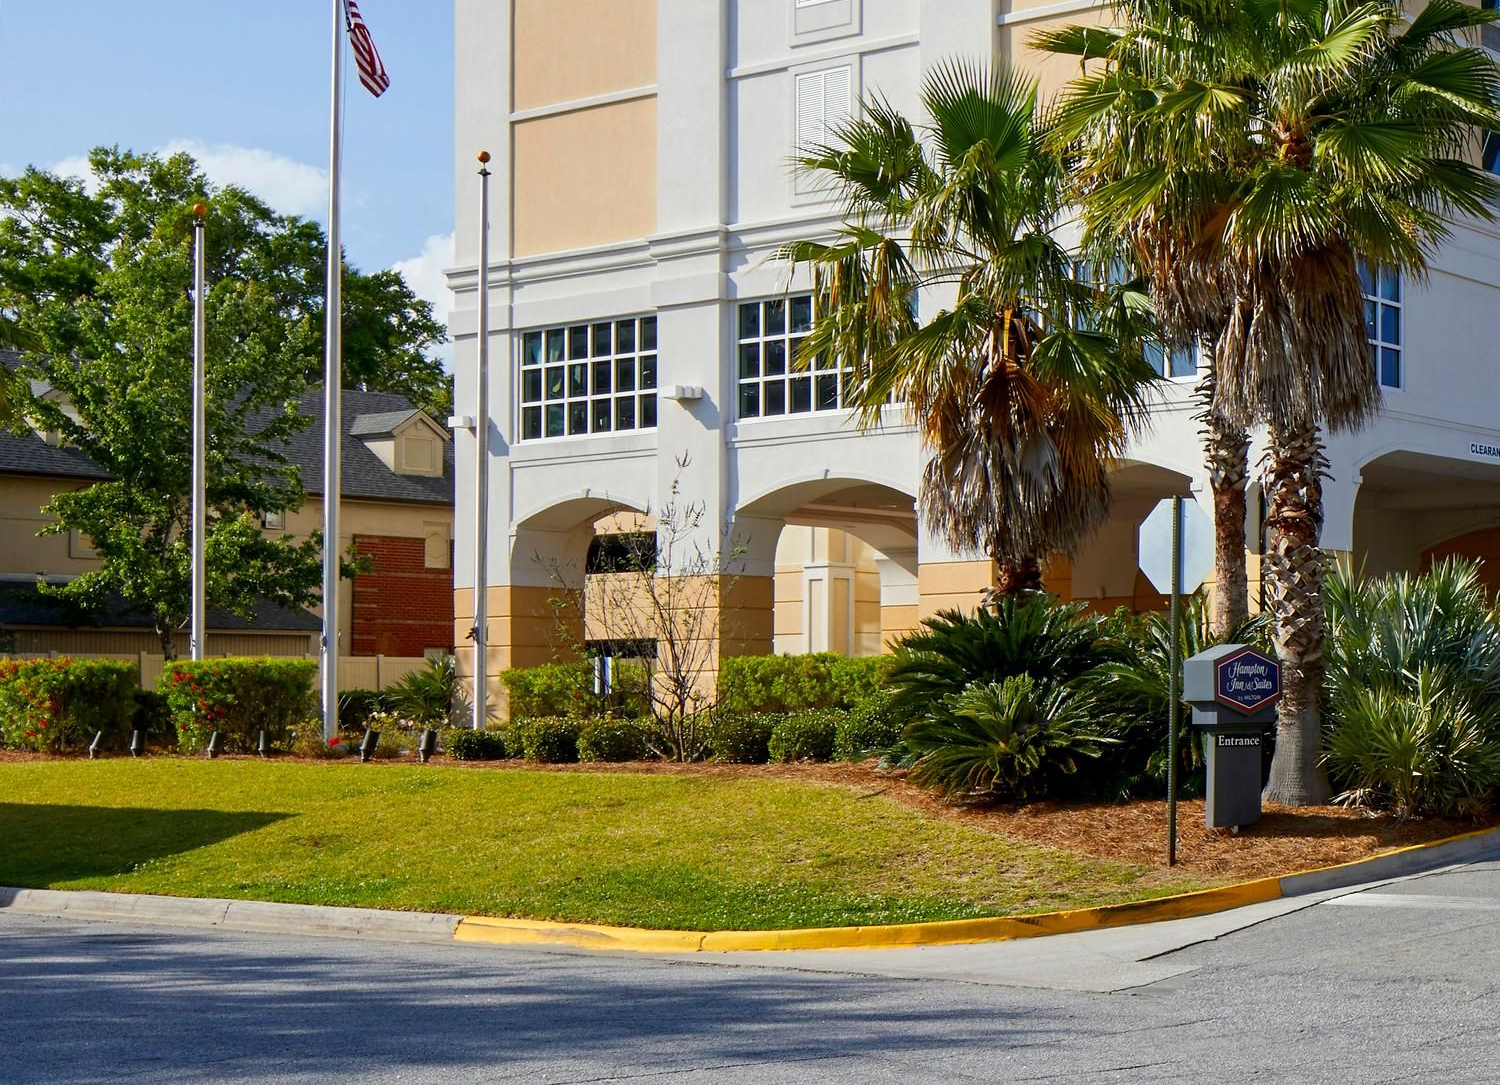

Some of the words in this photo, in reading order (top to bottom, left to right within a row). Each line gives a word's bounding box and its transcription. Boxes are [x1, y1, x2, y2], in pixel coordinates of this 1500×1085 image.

[1228, 661, 1268, 678] Hampton
[1226, 678, 1247, 692] Inn
[1251, 677, 1272, 691] Suites
[1218, 735, 1260, 746] Entrance
